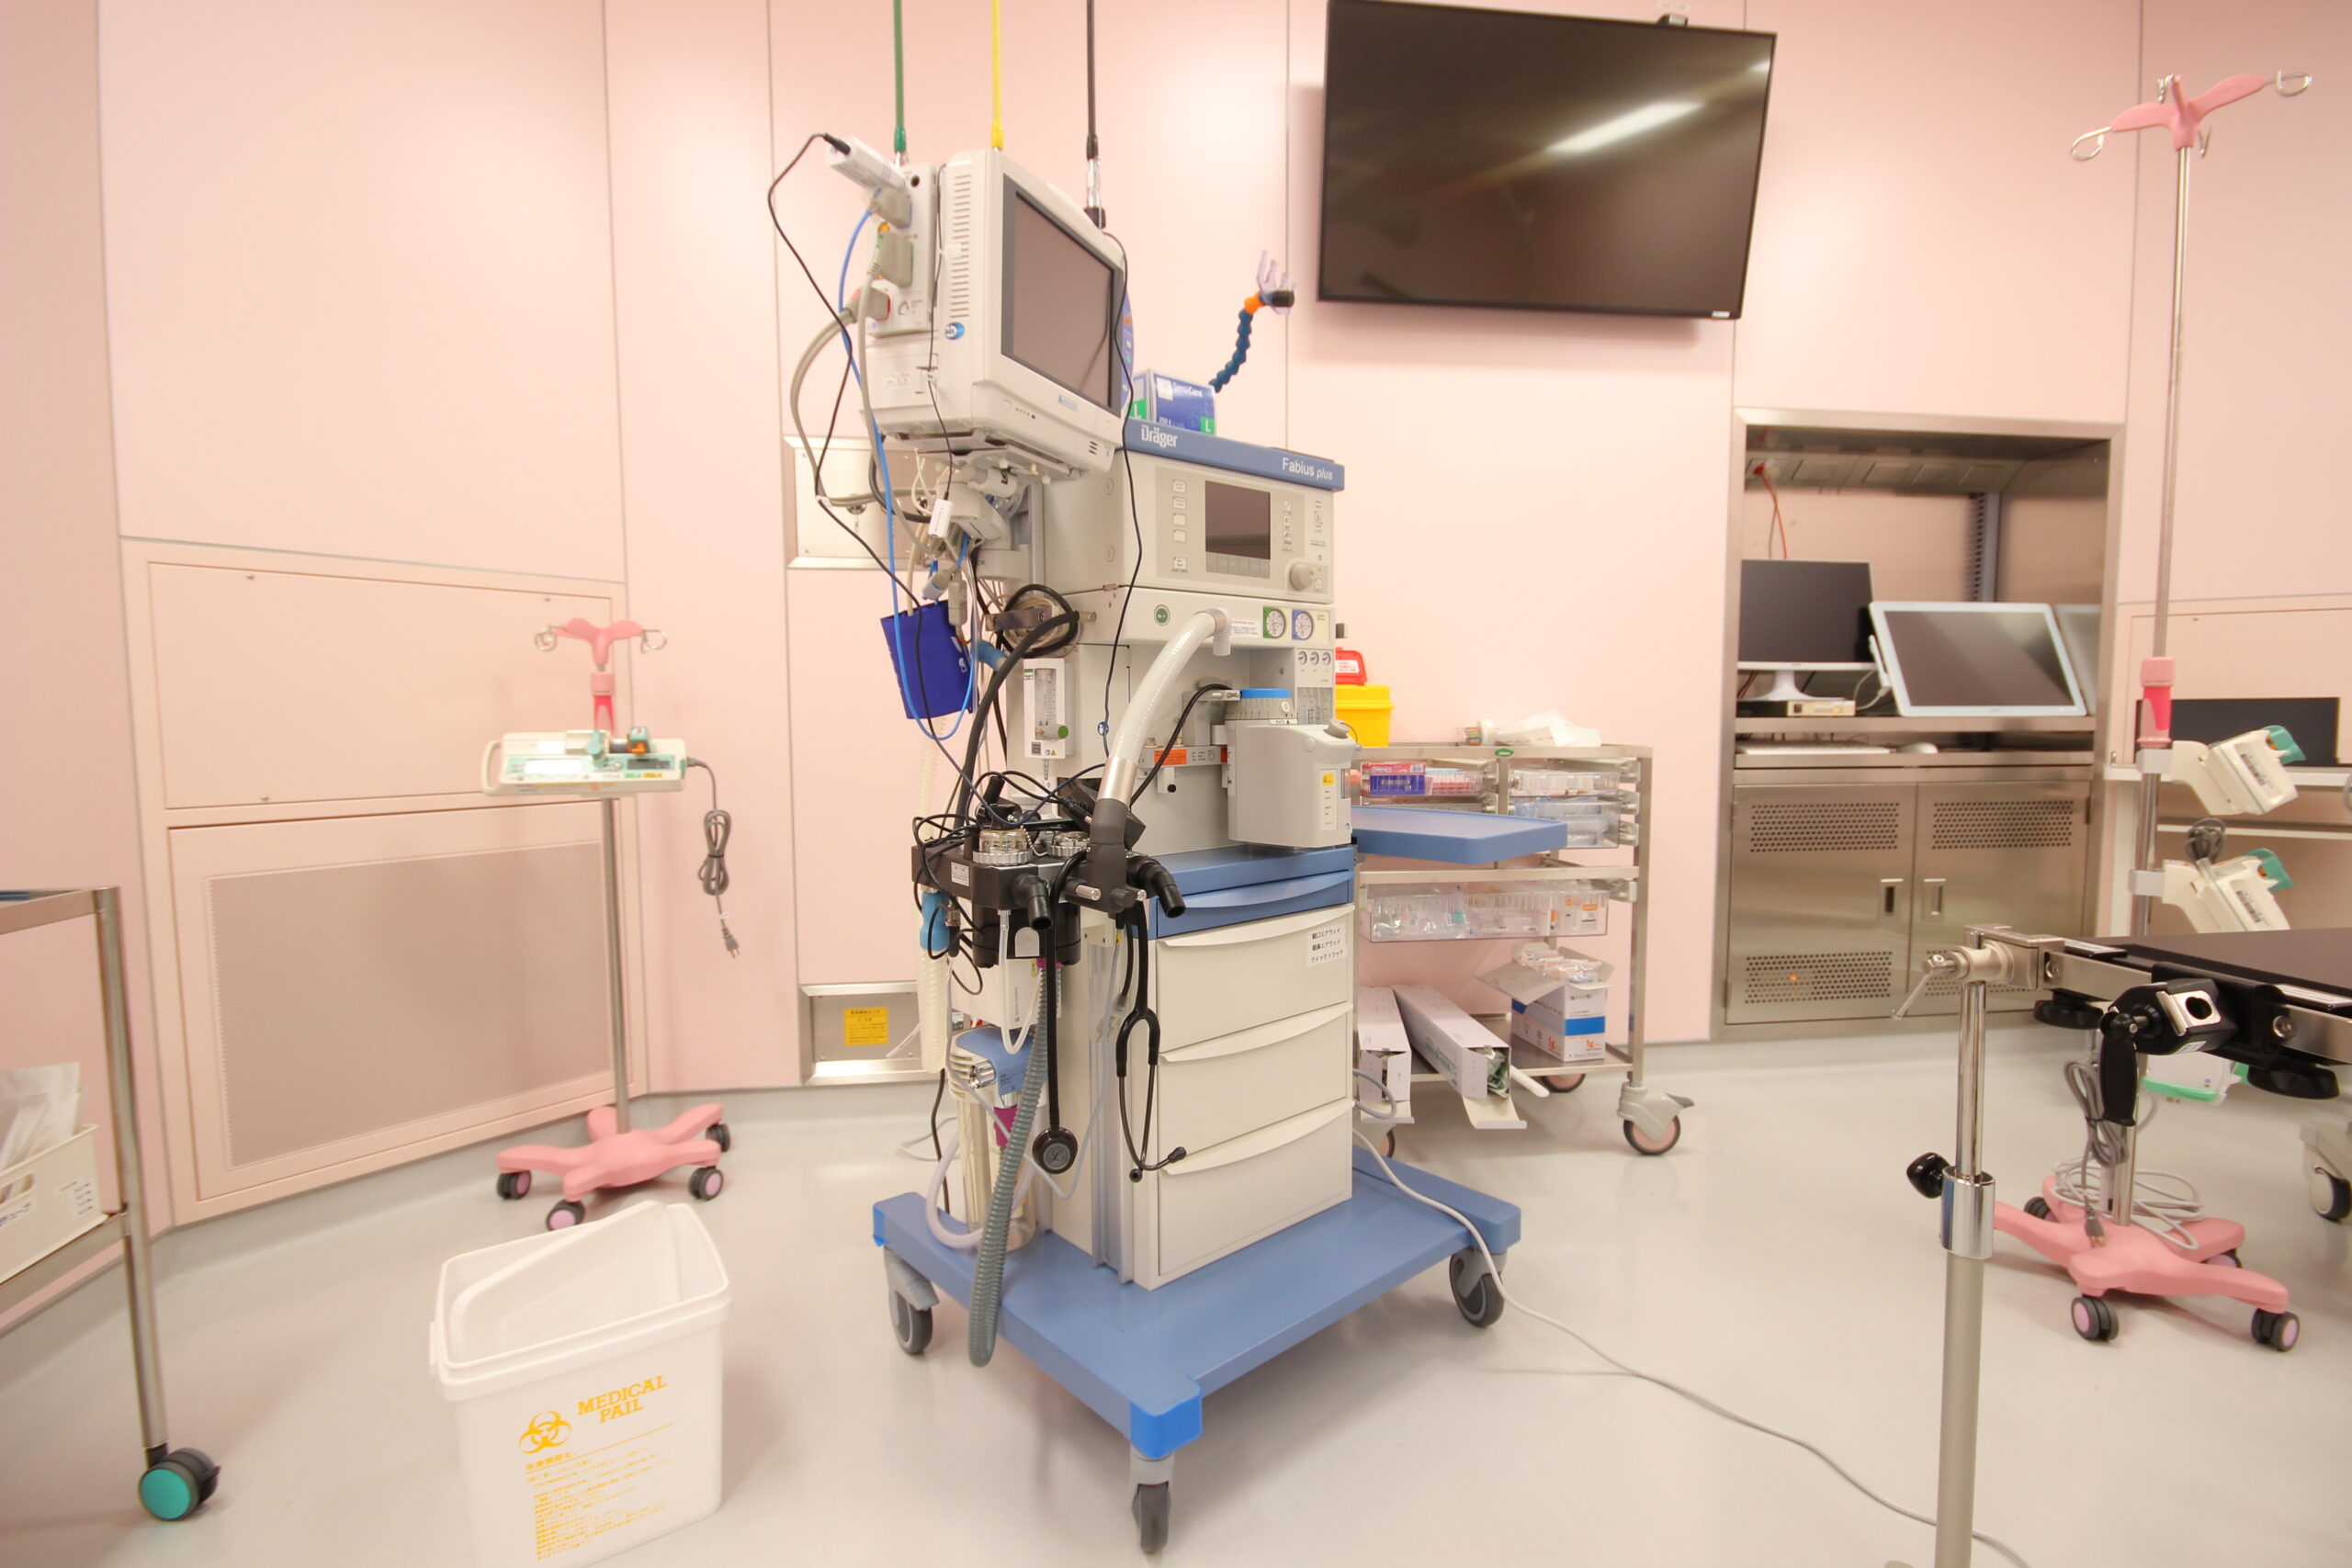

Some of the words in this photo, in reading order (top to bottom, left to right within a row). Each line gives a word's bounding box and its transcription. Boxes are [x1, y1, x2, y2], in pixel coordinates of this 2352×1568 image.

[1141, 424, 1178, 448] Dräger
[1204, 418, 1212, 433] L
[1283, 457, 1315, 477] Fabius
[1316, 468, 1333, 480] plus
[577, 1375, 668, 1416] MEDICAL
[599, 1398, 645, 1424] PAIL
